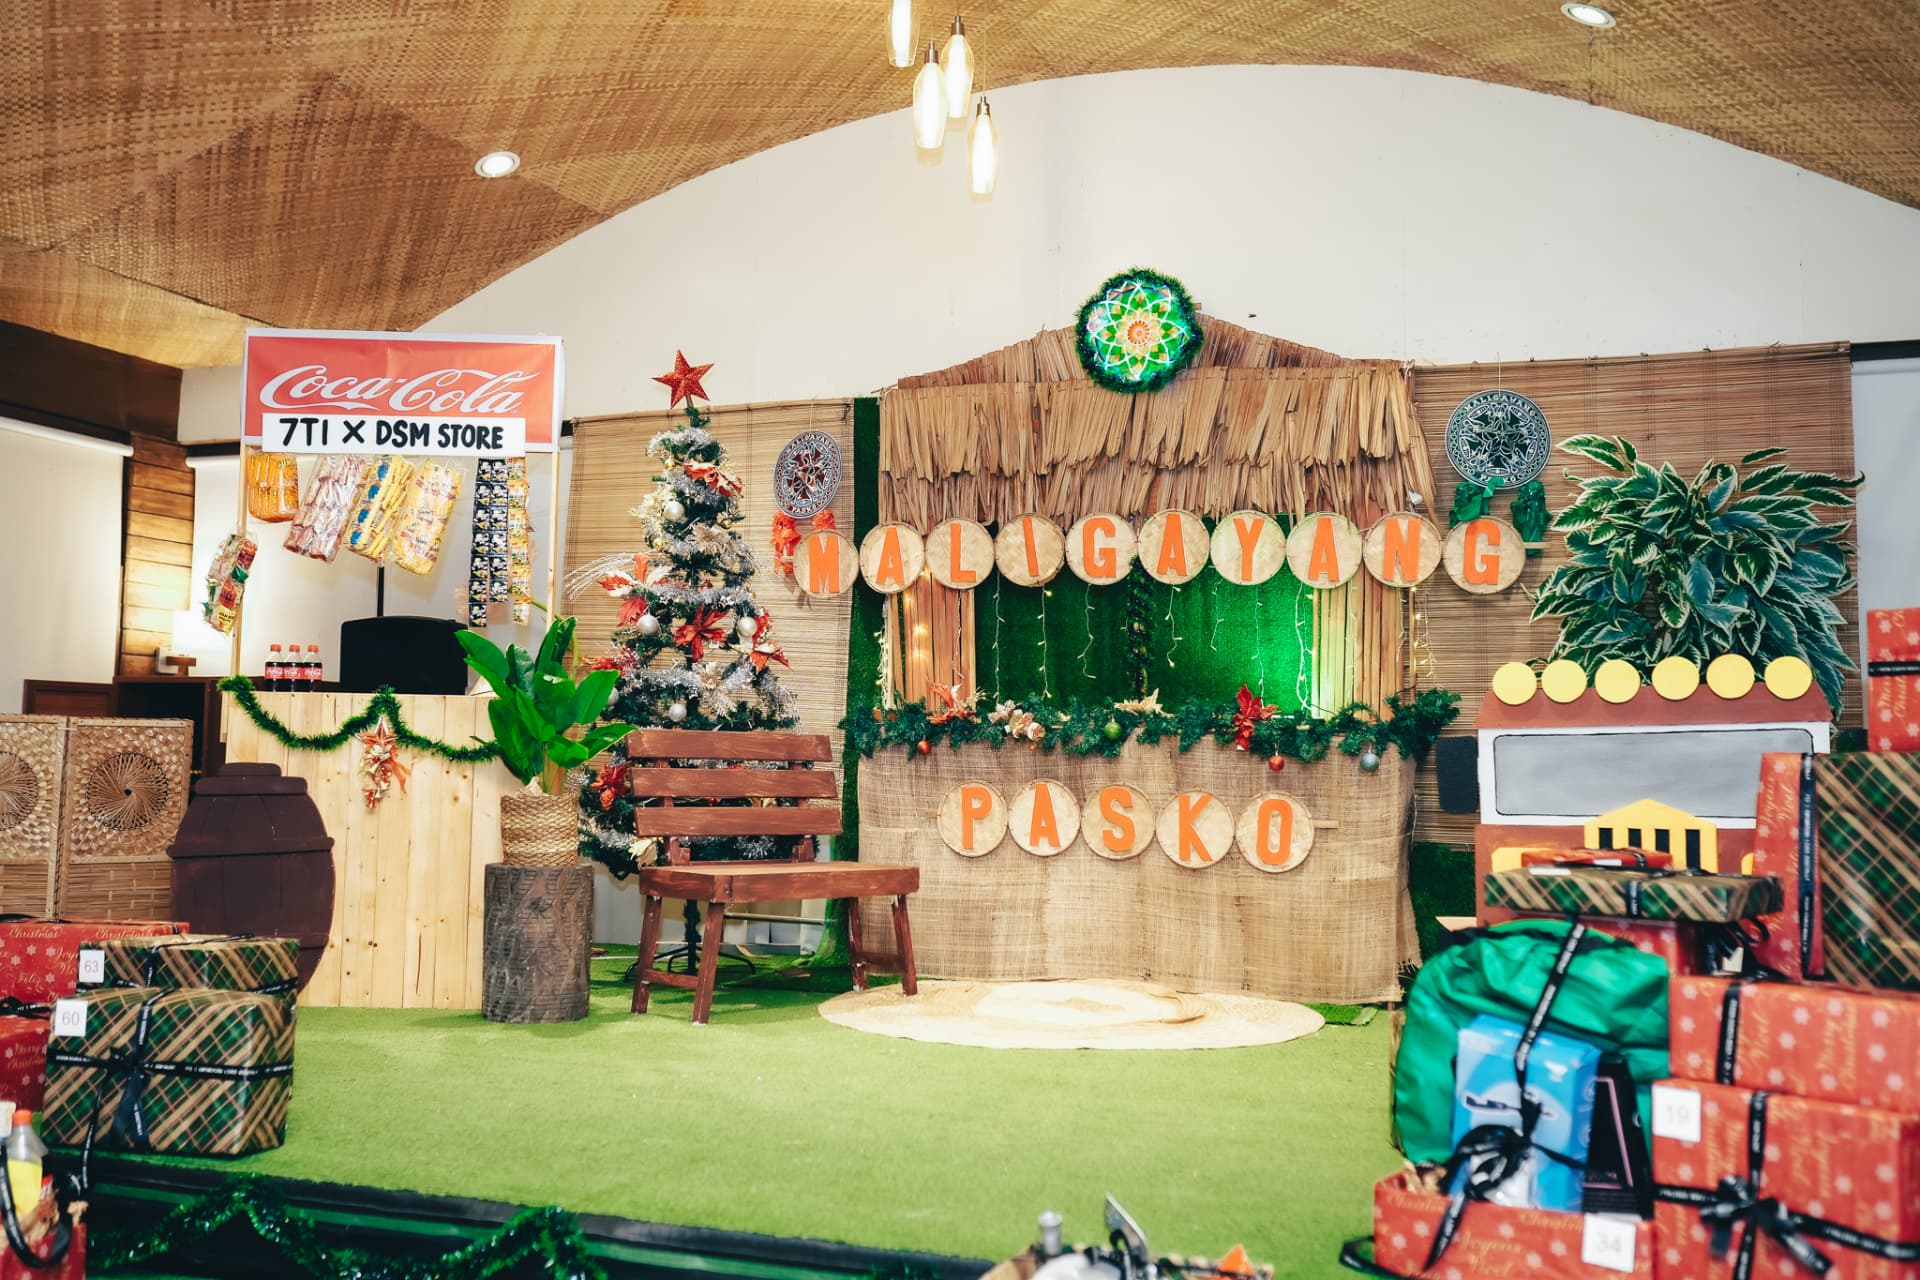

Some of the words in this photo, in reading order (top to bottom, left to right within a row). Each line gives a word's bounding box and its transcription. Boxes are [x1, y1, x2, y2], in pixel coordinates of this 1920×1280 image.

[259, 365, 541, 413] Coca-Cola
[279, 417, 328, 447] 7TI
[376, 419, 430, 449] DSM
[438, 423, 504, 450] STORE
[84, 960, 99, 974] 63
[62, 1011, 80, 1026] 60
